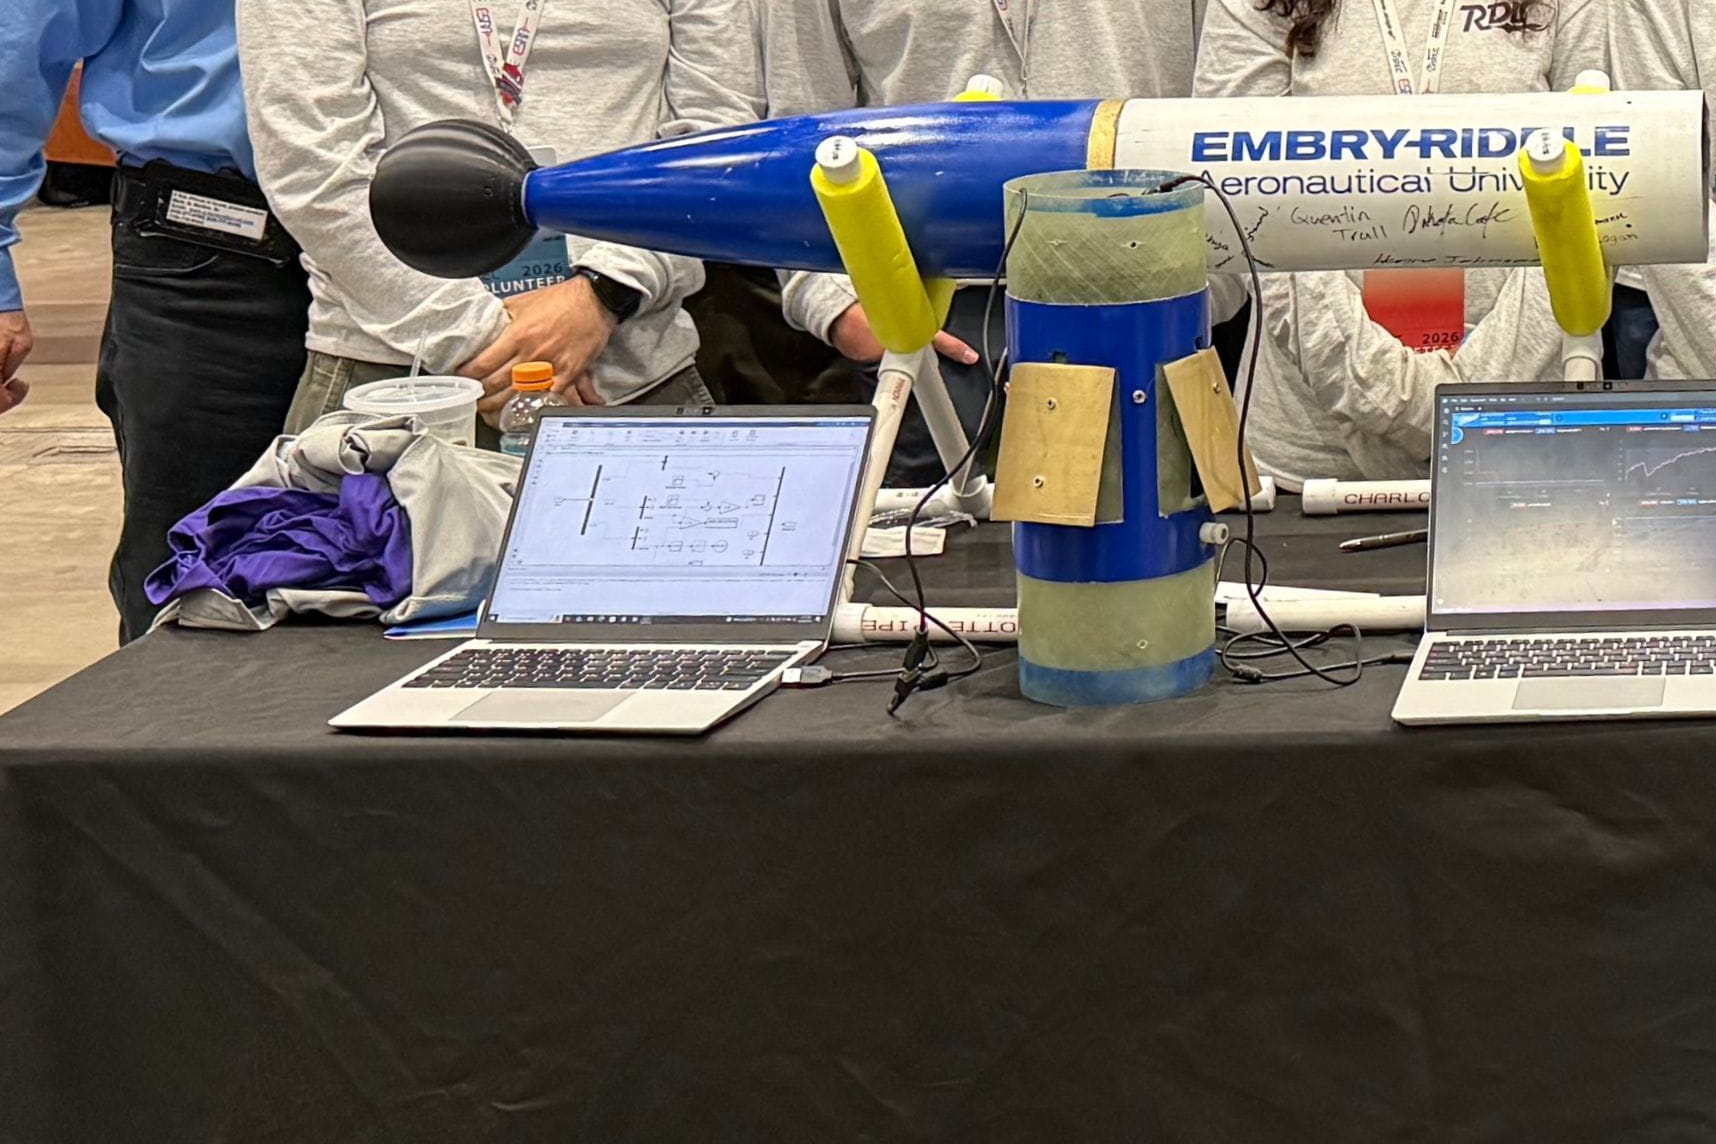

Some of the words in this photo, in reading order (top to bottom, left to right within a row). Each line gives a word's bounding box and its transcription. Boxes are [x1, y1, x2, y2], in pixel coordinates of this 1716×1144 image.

[1198, 168, 1432, 196] Aeronautical
[522, 262, 563, 276] 2026
[1422, 331, 1459, 344] 2026
